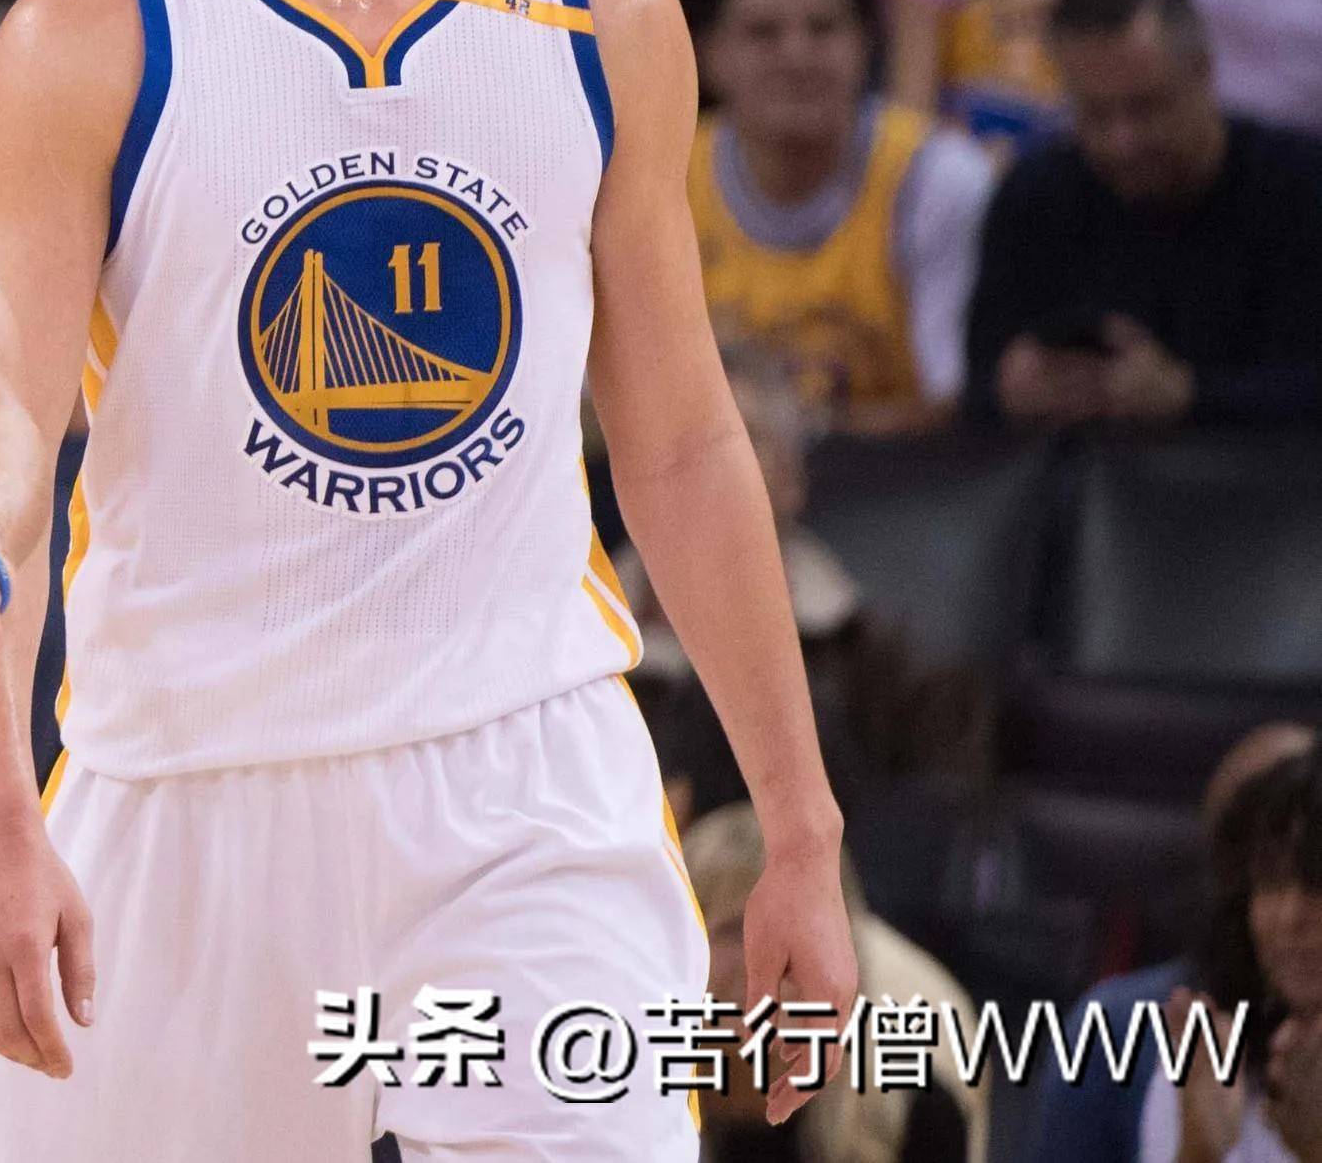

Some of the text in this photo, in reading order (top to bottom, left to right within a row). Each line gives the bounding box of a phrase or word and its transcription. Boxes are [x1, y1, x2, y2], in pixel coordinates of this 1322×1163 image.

[241, 151, 530, 246] GOLDEN STATE
[388, 242, 442, 314] 11
[243, 407, 526, 514] WARRIORS
